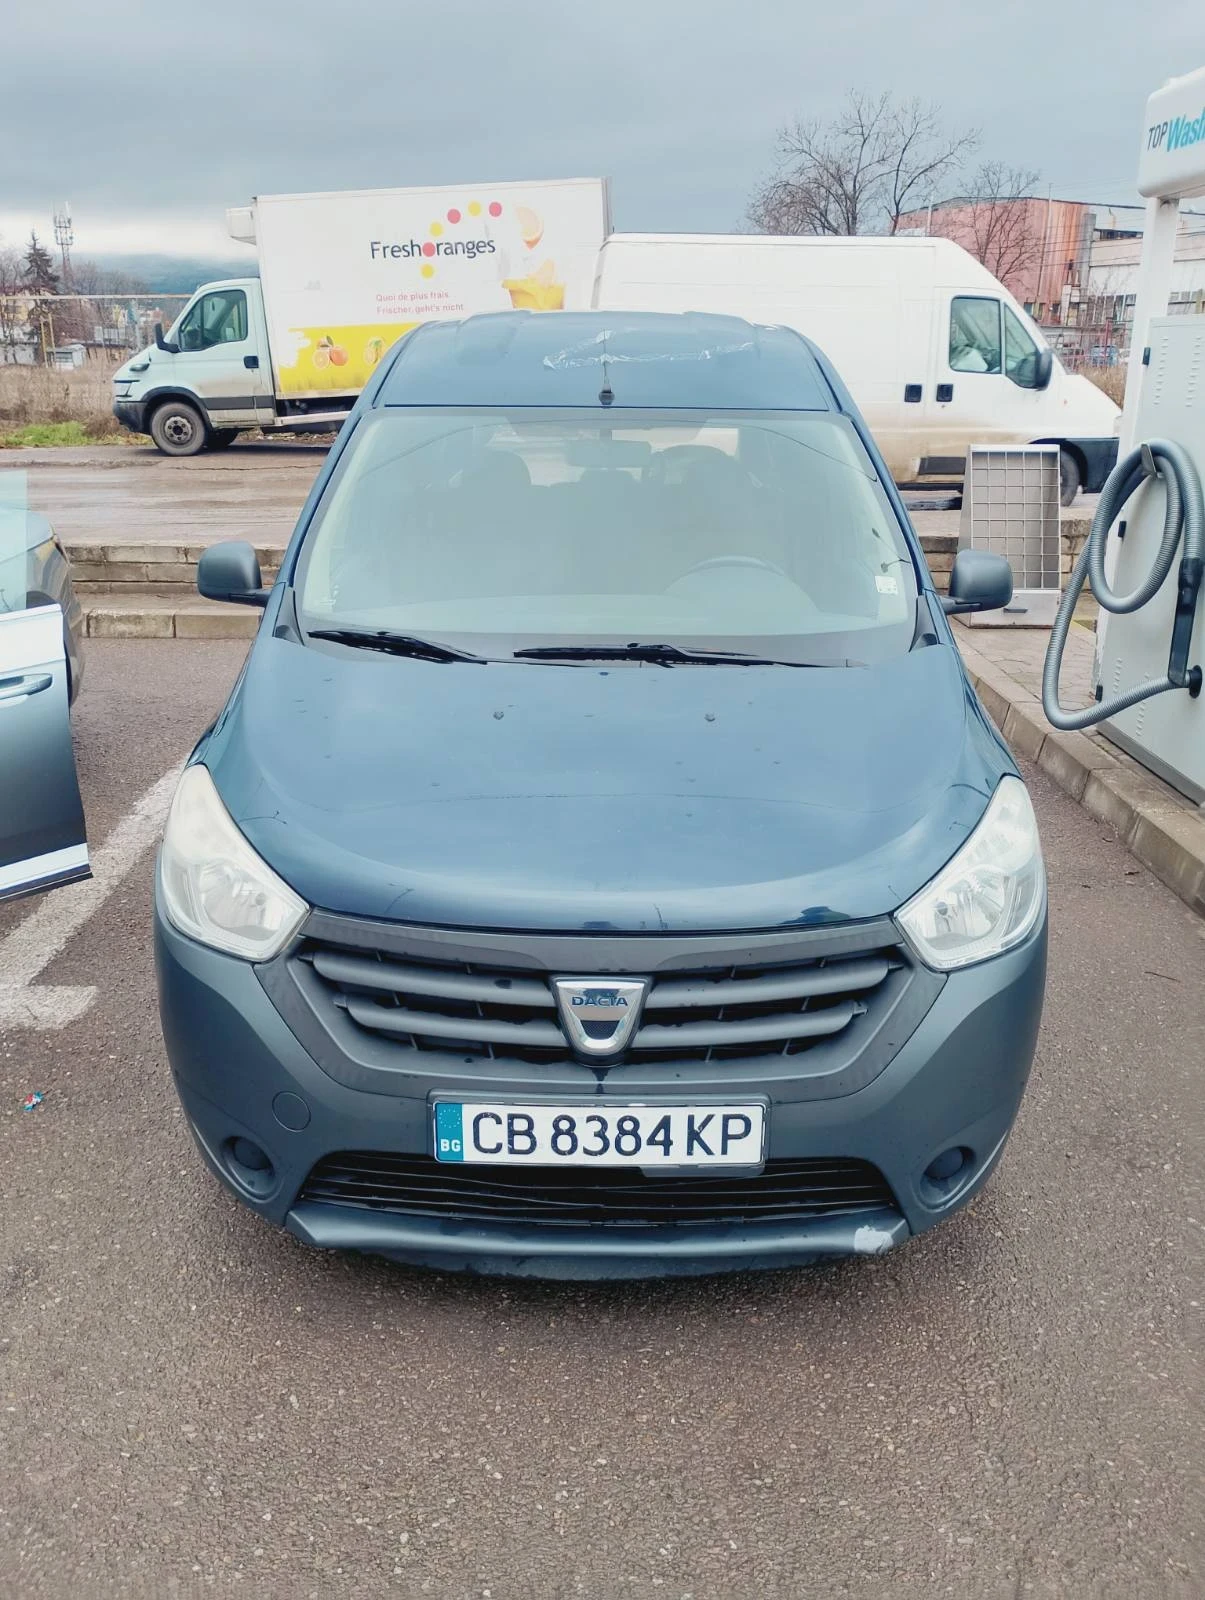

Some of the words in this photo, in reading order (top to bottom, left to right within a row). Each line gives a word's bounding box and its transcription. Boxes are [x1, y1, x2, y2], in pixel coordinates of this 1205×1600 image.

[376, 293, 396, 302] Quoi
[398, 293, 408, 301] de
[410, 291, 428, 302] plus
[430, 290, 449, 299] frais
[442, 302, 464, 312] nicht
[571, 996, 629, 1007] DACIA
[472, 1112, 537, 1155] CB
[550, 1113, 674, 1157] 8384
[686, 1113, 752, 1157] KP
[440, 1138, 461, 1152] BG
